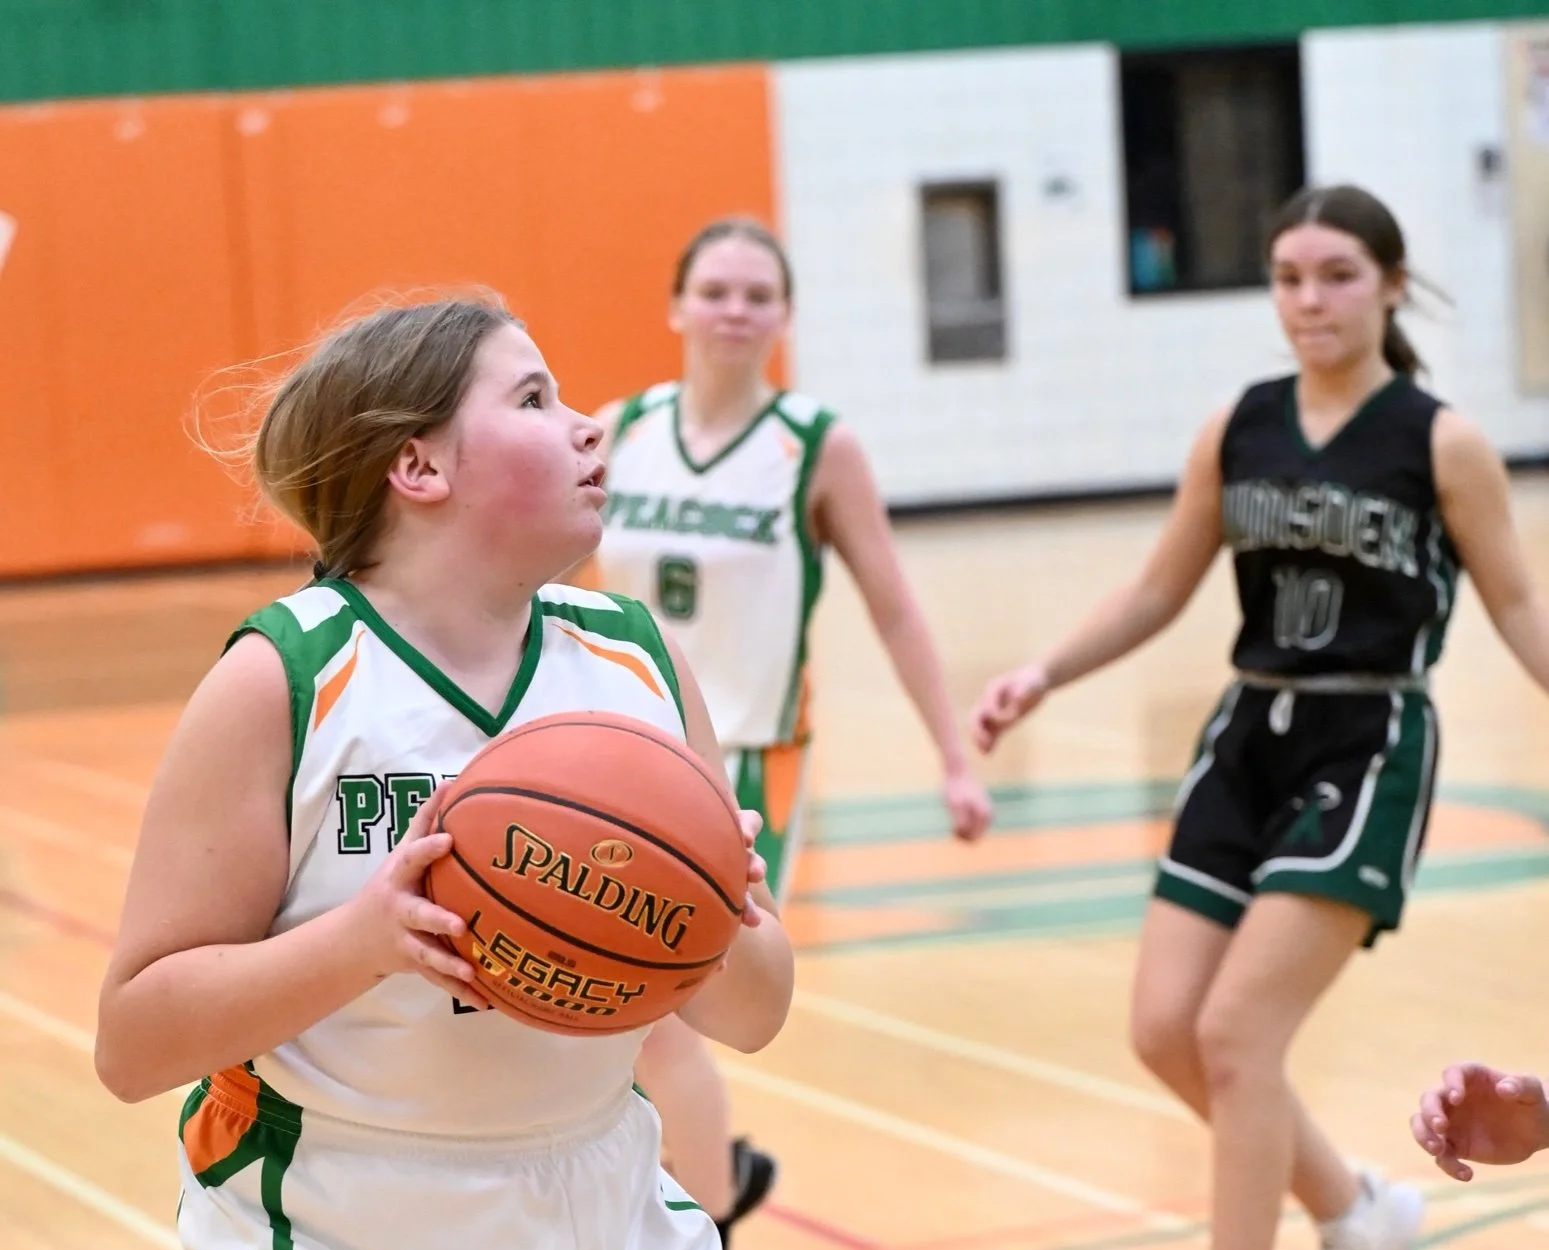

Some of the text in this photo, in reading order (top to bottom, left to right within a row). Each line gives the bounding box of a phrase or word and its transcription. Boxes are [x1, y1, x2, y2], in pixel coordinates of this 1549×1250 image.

[1222, 479, 1420, 579] UMSDEN
[657, 554, 698, 622] 6
[1271, 563, 1345, 651] 10
[336, 772, 460, 855] PE
[491, 821, 696, 952] SPALDING
[467, 909, 647, 1006] LEGACY
